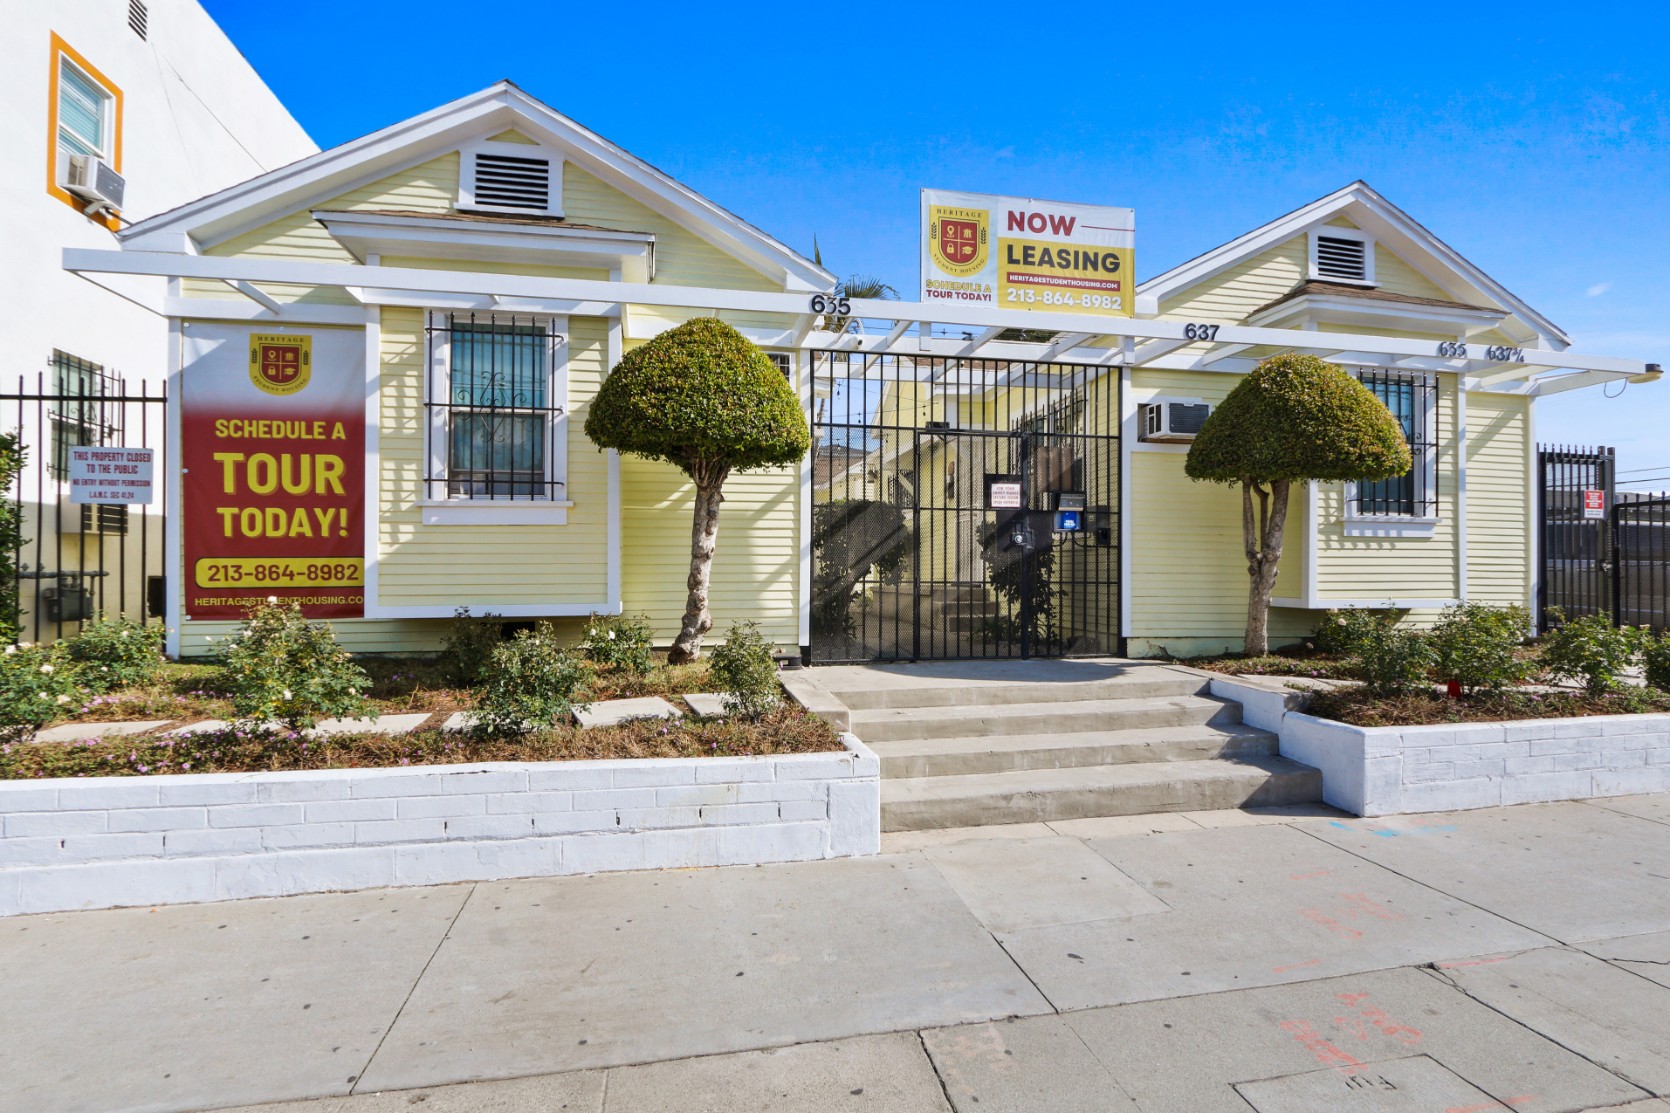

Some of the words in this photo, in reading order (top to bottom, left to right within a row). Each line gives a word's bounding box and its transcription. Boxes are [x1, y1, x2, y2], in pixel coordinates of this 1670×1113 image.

[937, 209, 982, 218] HERITAGE
[1007, 210, 1076, 236] NOW
[1007, 244, 1120, 272] LEASING
[926, 280, 981, 292] SCHEDULE
[984, 284, 992, 293] A
[1010, 275, 1117, 288] HERITAGESTUDENTHOUSING.COM
[926, 290, 952, 298] TOUR
[955, 292, 991, 301] TODAY!
[1008, 288, 1121, 310] 213-864-8982
[812, 295, 851, 315] 635
[1185, 323, 1220, 340] 637
[1440, 342, 1466, 357] 635
[215, 419, 326, 440] SCHEDULE
[332, 422, 346, 440] A
[74, 451, 88, 460] THIS
[91, 452, 124, 461] PROPERTY
[127, 453, 151, 462] CLOSED
[87, 464, 95, 473] TO
[98, 464, 111, 473] THE
[114, 464, 138, 474] PUBLIC
[213, 452, 346, 496] TOUR
[216, 507, 349, 538] TODAY!
[207, 564, 359, 582] 213-864-8982
[195, 596, 363, 606] HERITAGESTUENTHOUSING.CO
